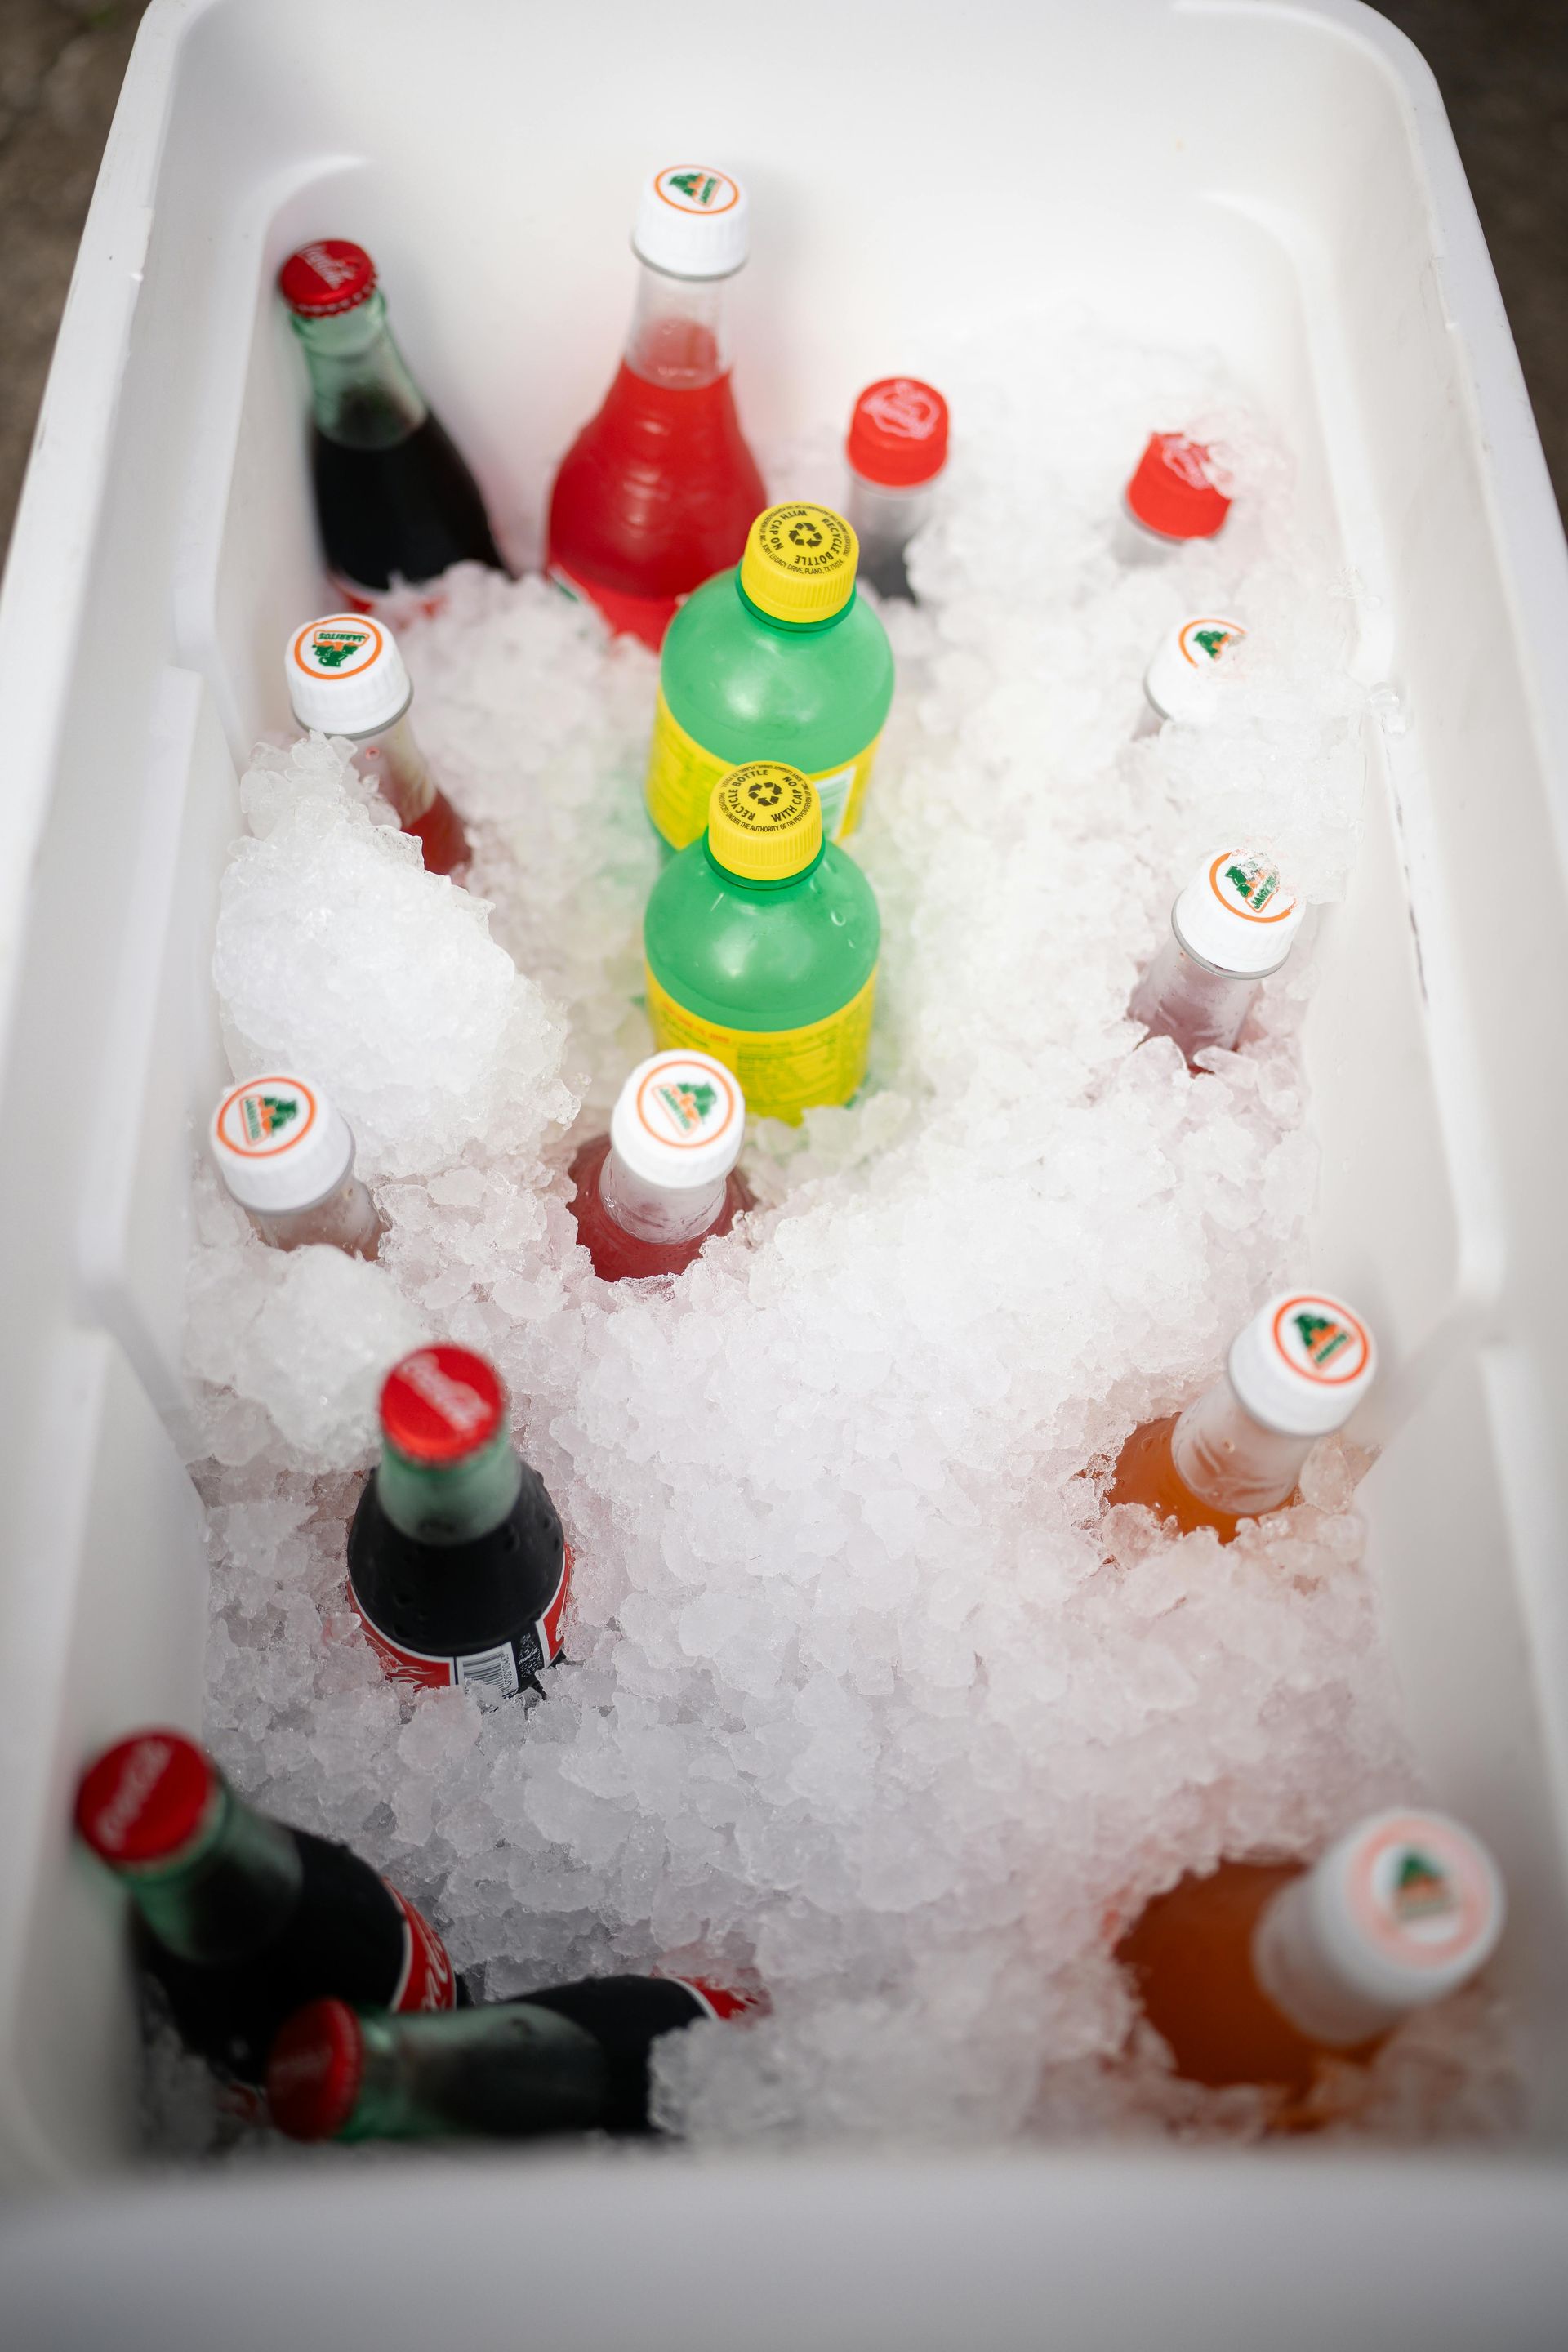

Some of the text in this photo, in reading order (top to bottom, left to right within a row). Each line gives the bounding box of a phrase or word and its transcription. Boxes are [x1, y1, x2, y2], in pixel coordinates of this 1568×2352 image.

[769, 519, 782, 535] CAP
[780, 510, 808, 520] WITH
[770, 537, 784, 551] ON
[794, 518, 843, 566] RECYCLE BOTTLE
[769, 553, 787, 568] LEGACY
[728, 769, 768, 821] RECYCLE BOTTLE
[770, 776, 802, 822] WITH CAP ON
[719, 792, 728, 813] PRODUCED
[726, 811, 741, 825] UNDER
[740, 821, 751, 830] THE
[787, 819, 795, 827] DR
